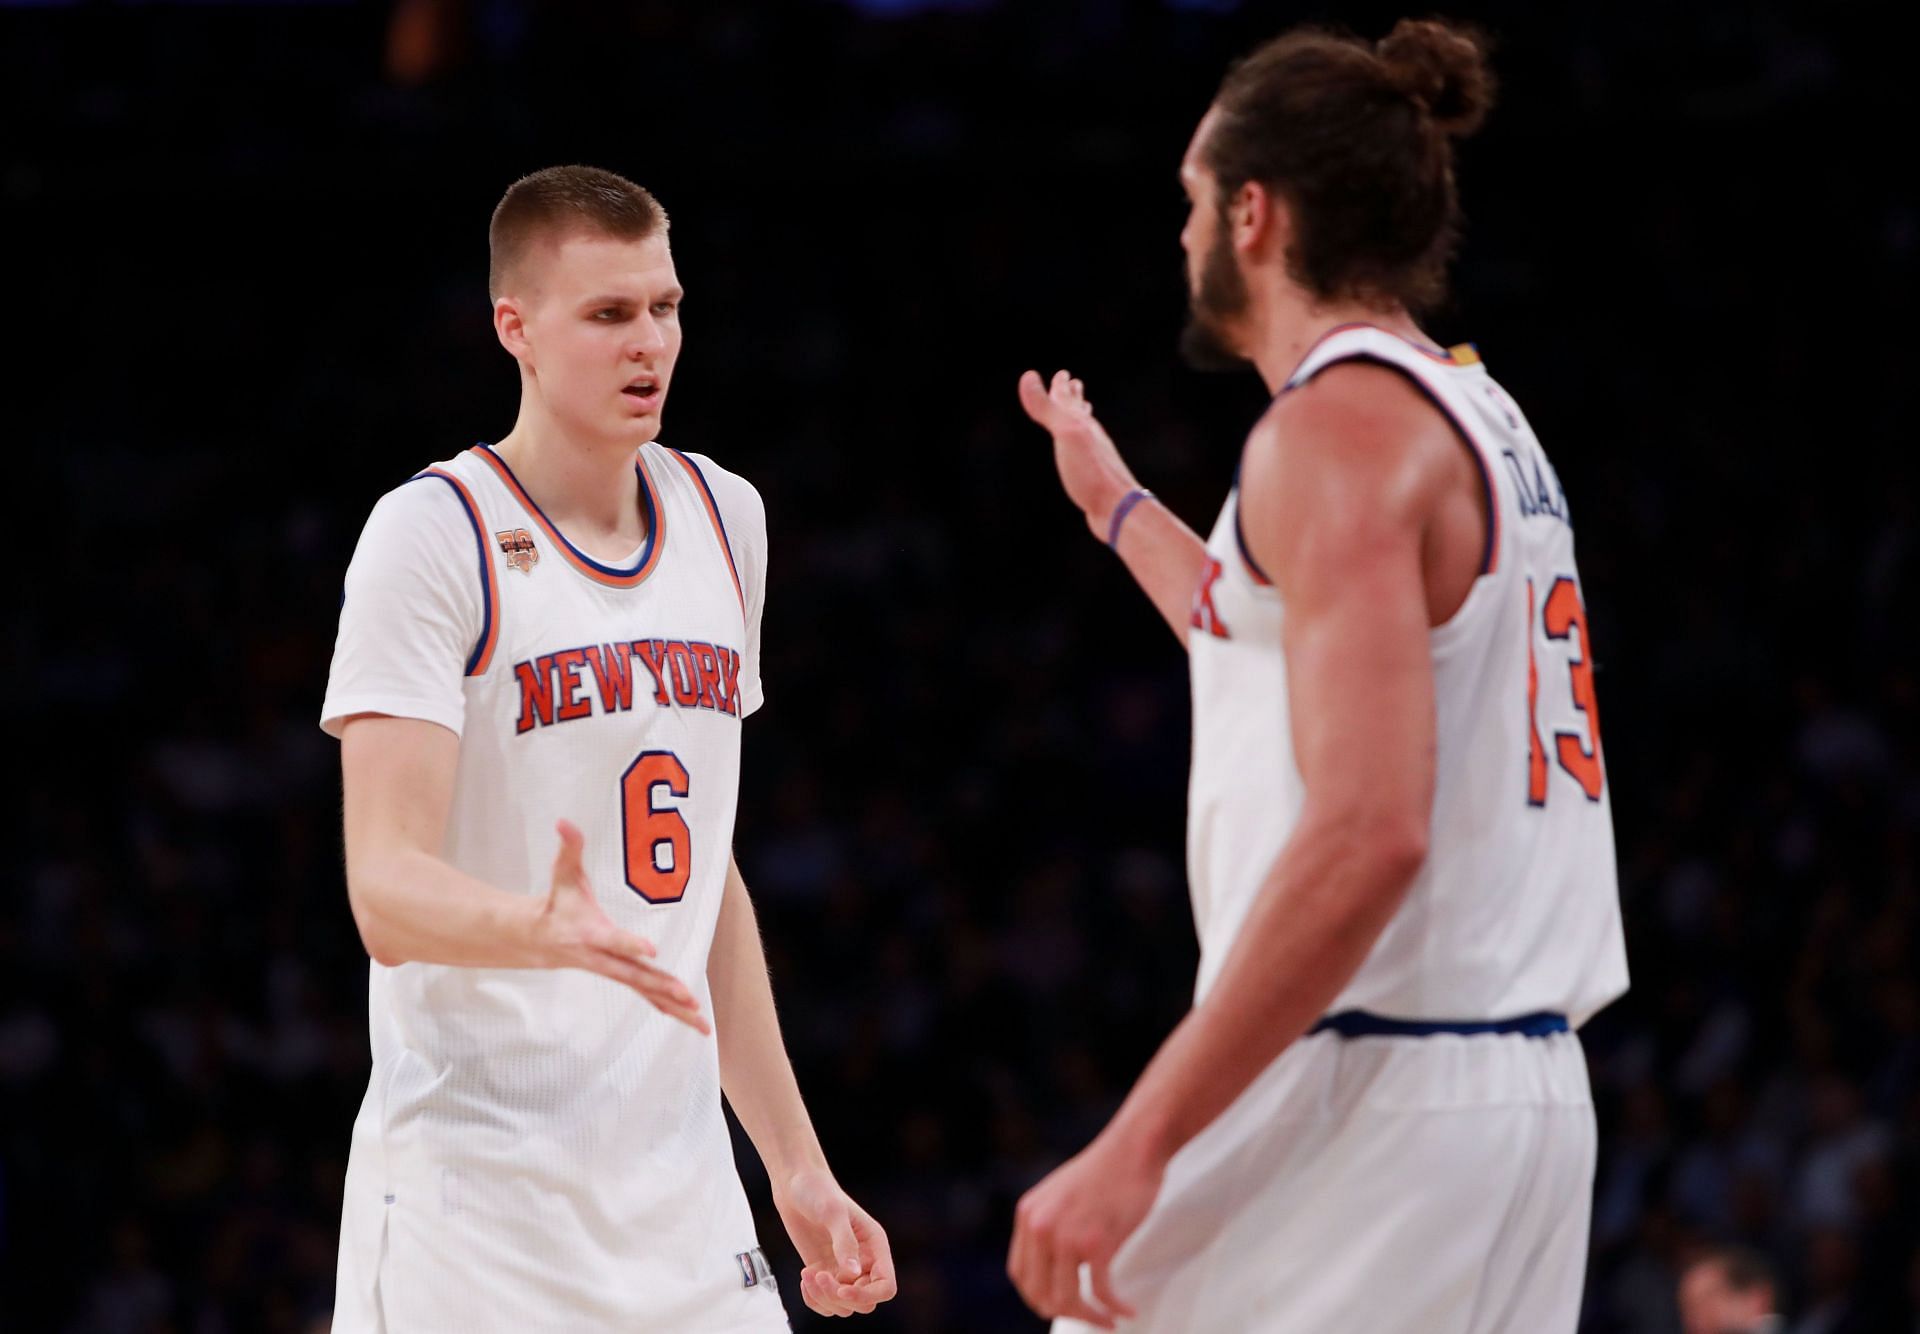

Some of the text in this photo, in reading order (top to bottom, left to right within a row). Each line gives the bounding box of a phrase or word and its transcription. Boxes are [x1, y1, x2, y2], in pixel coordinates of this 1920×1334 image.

[514, 638, 742, 736] NEW YORK
[1527, 574, 1603, 808] 13
[620, 750, 691, 905] 6
